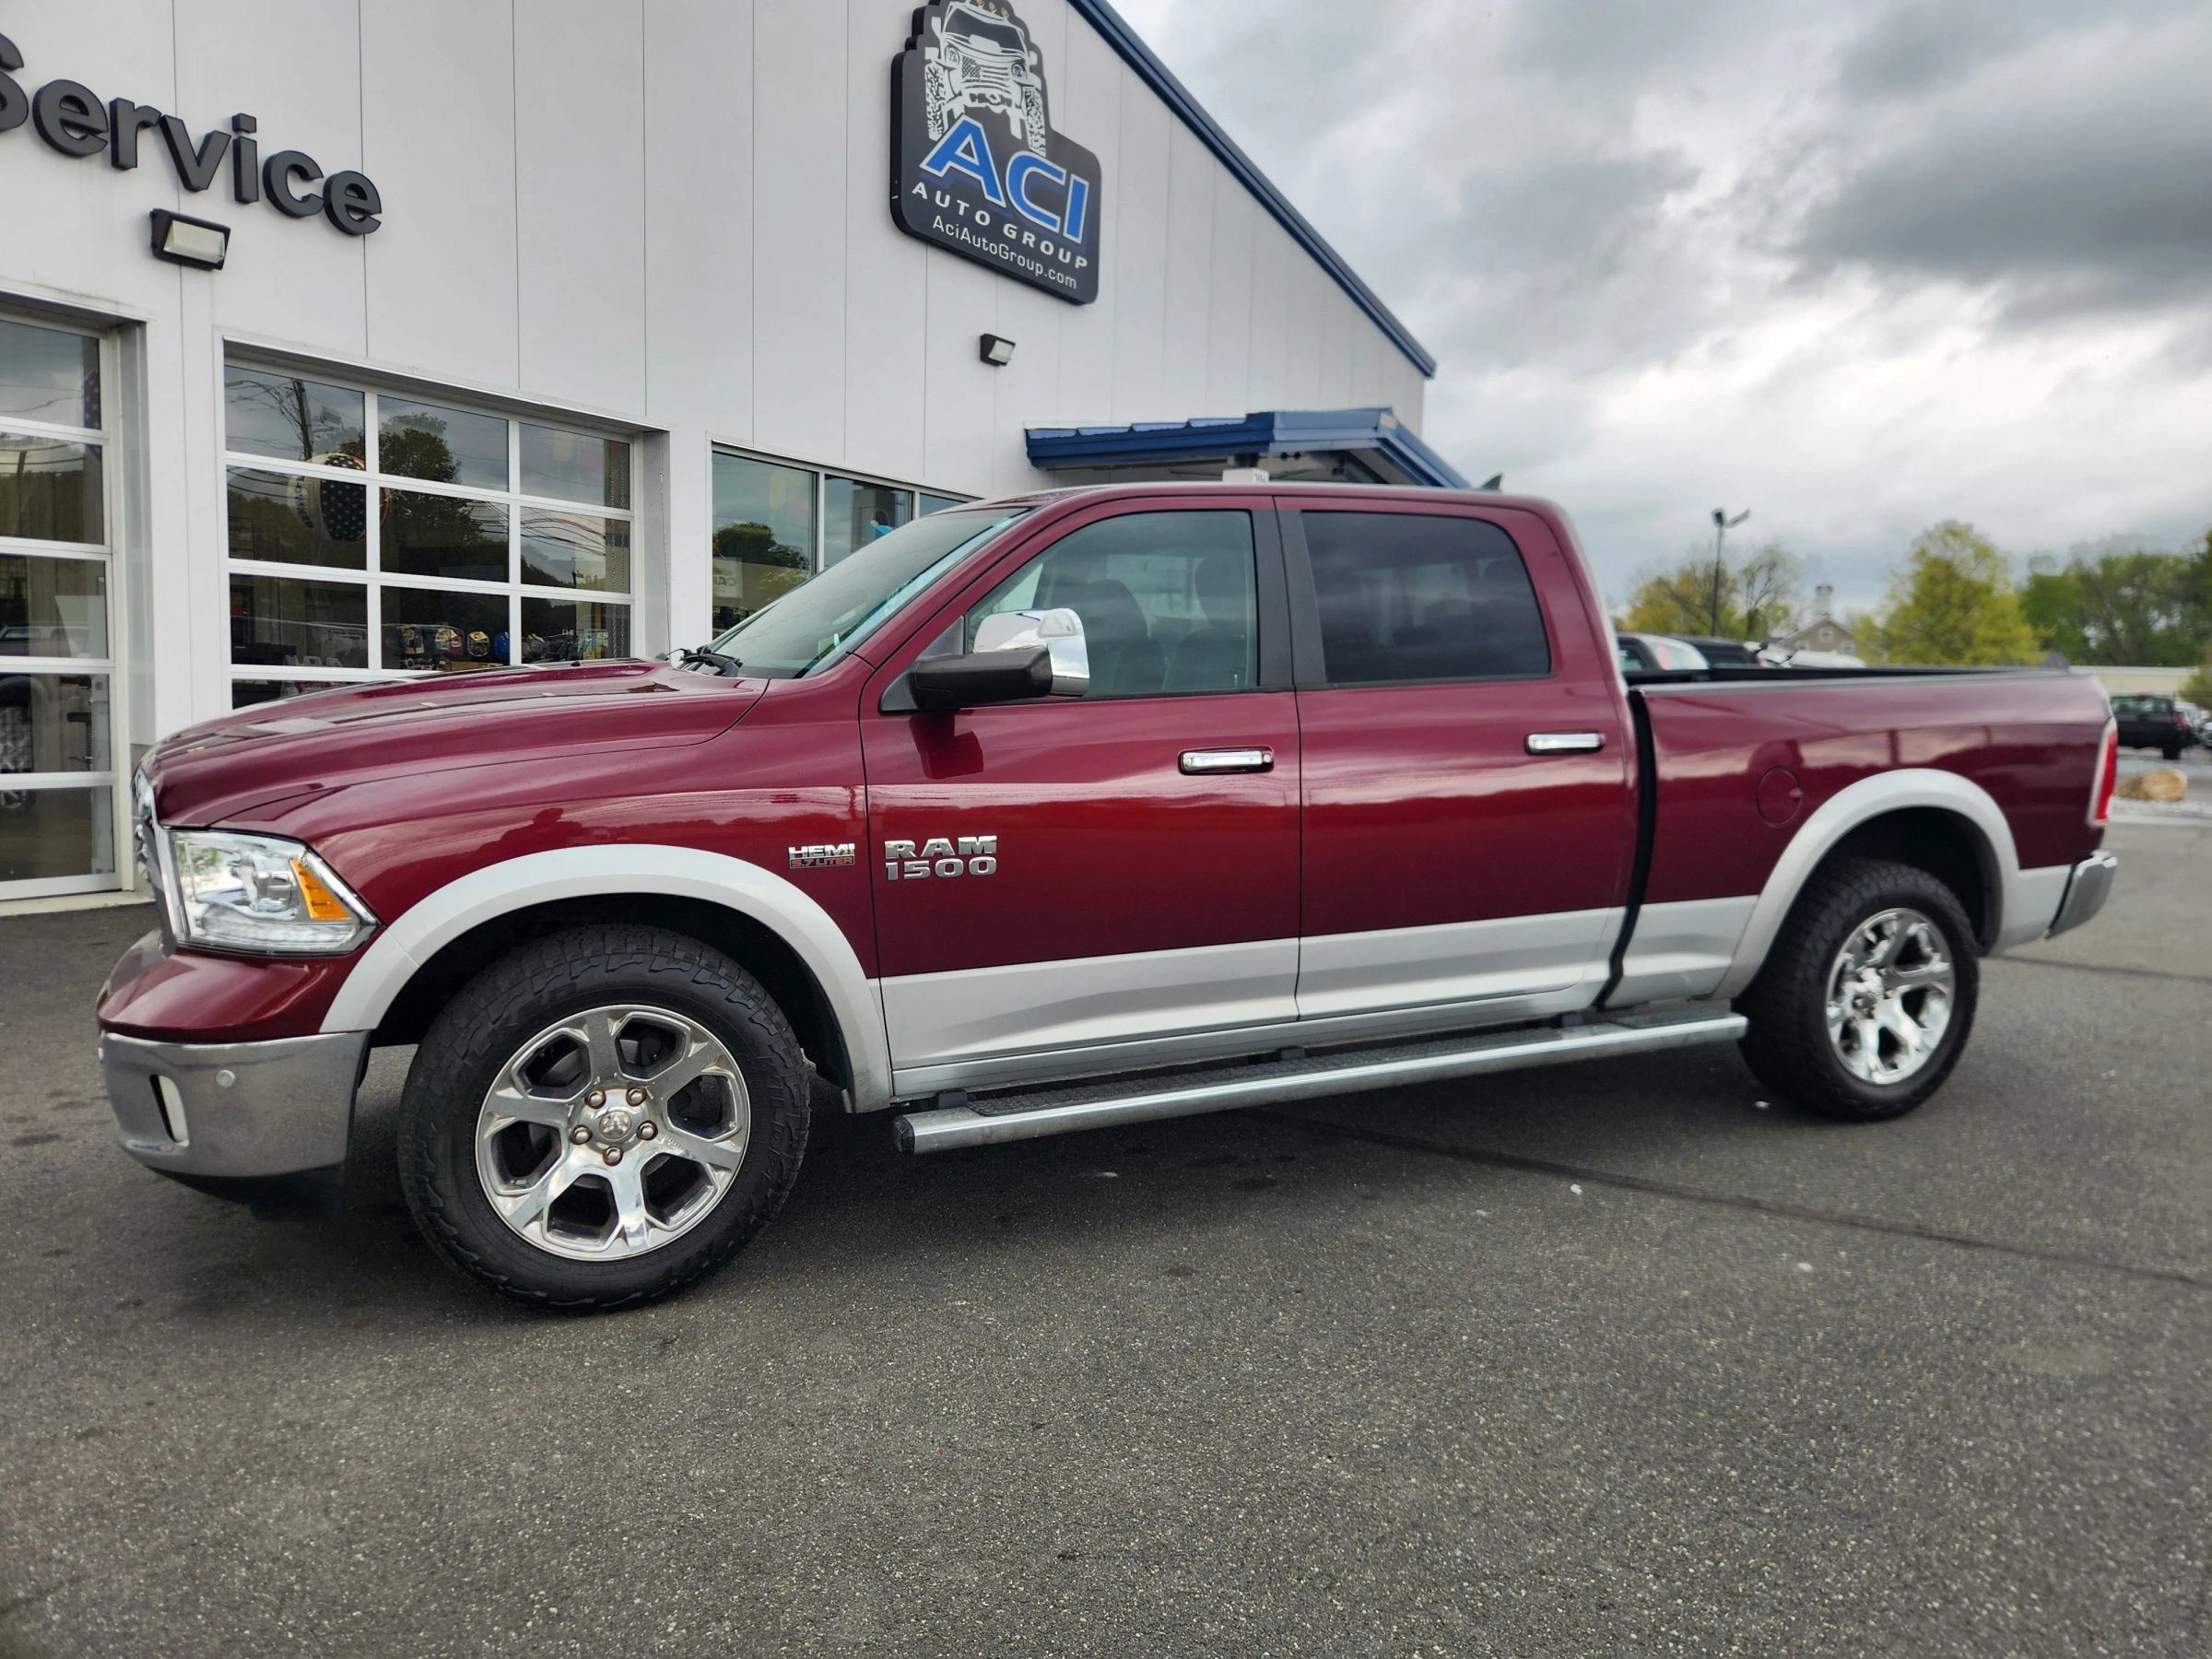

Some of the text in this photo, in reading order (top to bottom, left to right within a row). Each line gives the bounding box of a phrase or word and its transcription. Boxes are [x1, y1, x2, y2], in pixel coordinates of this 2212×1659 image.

[919, 113, 1089, 244] ACI
[912, 182, 1088, 269] AUTO GROUP
[933, 215, 1077, 289] AciAutoGroup.com
[788, 842, 855, 858] HEMI
[884, 835, 997, 859] RAM
[885, 855, 997, 881] 1500
